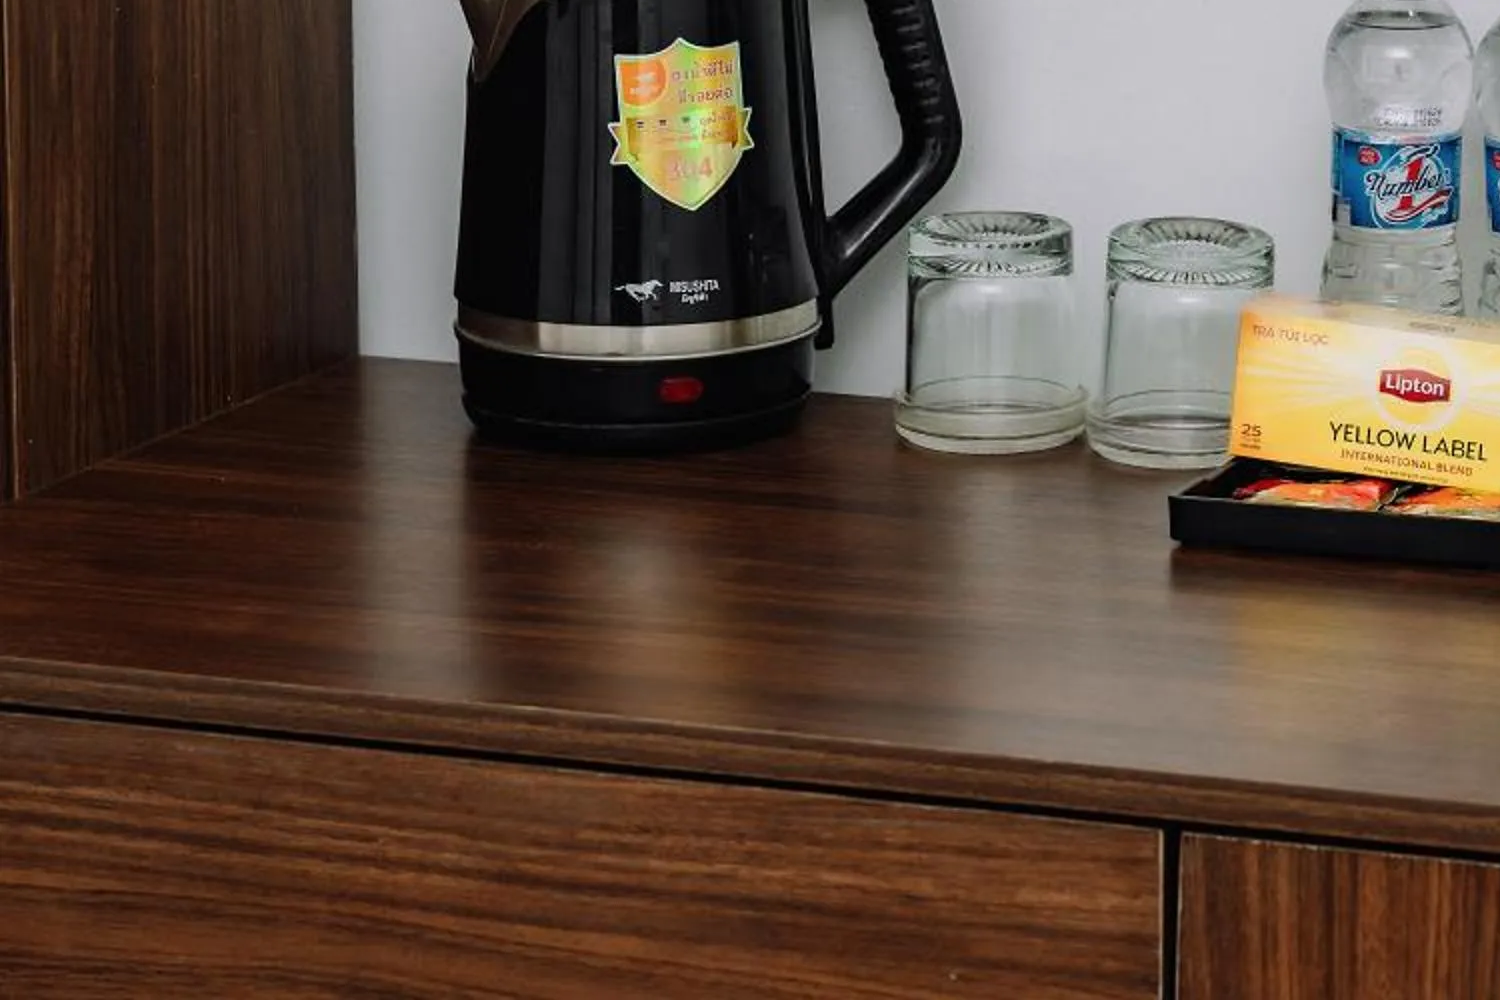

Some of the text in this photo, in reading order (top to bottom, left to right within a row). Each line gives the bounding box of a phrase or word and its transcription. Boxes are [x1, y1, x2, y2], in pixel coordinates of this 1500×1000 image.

[1385, 373, 1445, 397] Lipton
[1241, 423, 1261, 437] 25
[1329, 421, 1488, 462] YELLOW LABEL
[1340, 448, 1435, 471] INTERNATIONAL
[1436, 461, 1474, 477] BLEND
